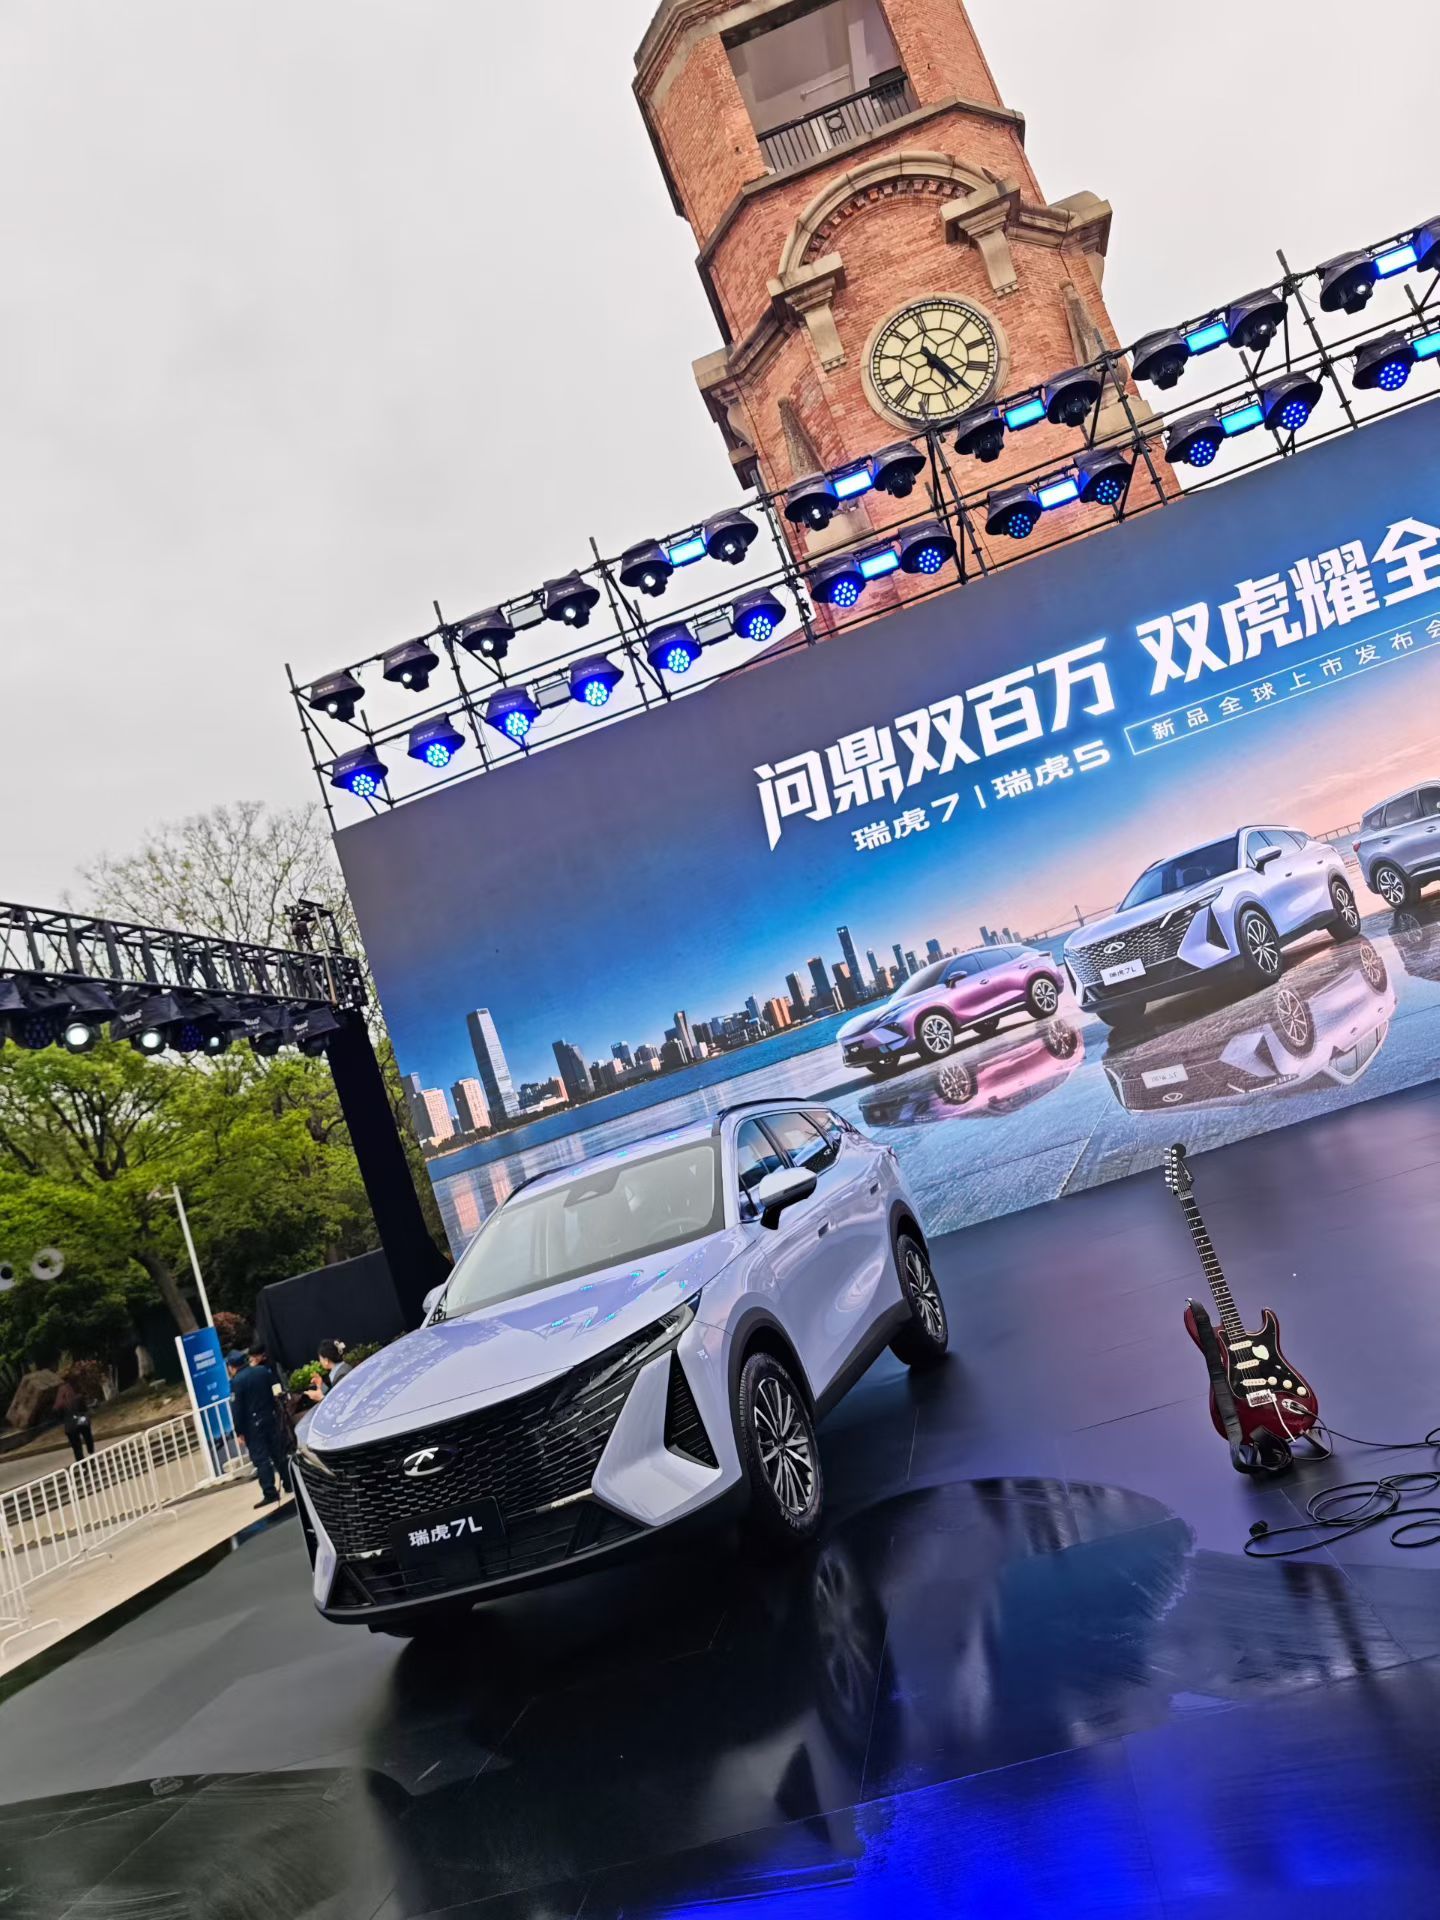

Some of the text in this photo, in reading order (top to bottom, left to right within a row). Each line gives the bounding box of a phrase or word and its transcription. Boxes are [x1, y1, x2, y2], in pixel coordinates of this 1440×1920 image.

[753, 516, 1440, 852] 问鼎双百万 双虎耀全
[851, 792, 960, 851] 瑞虎7
[991, 739, 1112, 800] 瑞虎5
[408, 1516, 483, 1547] 瑞虎7L
